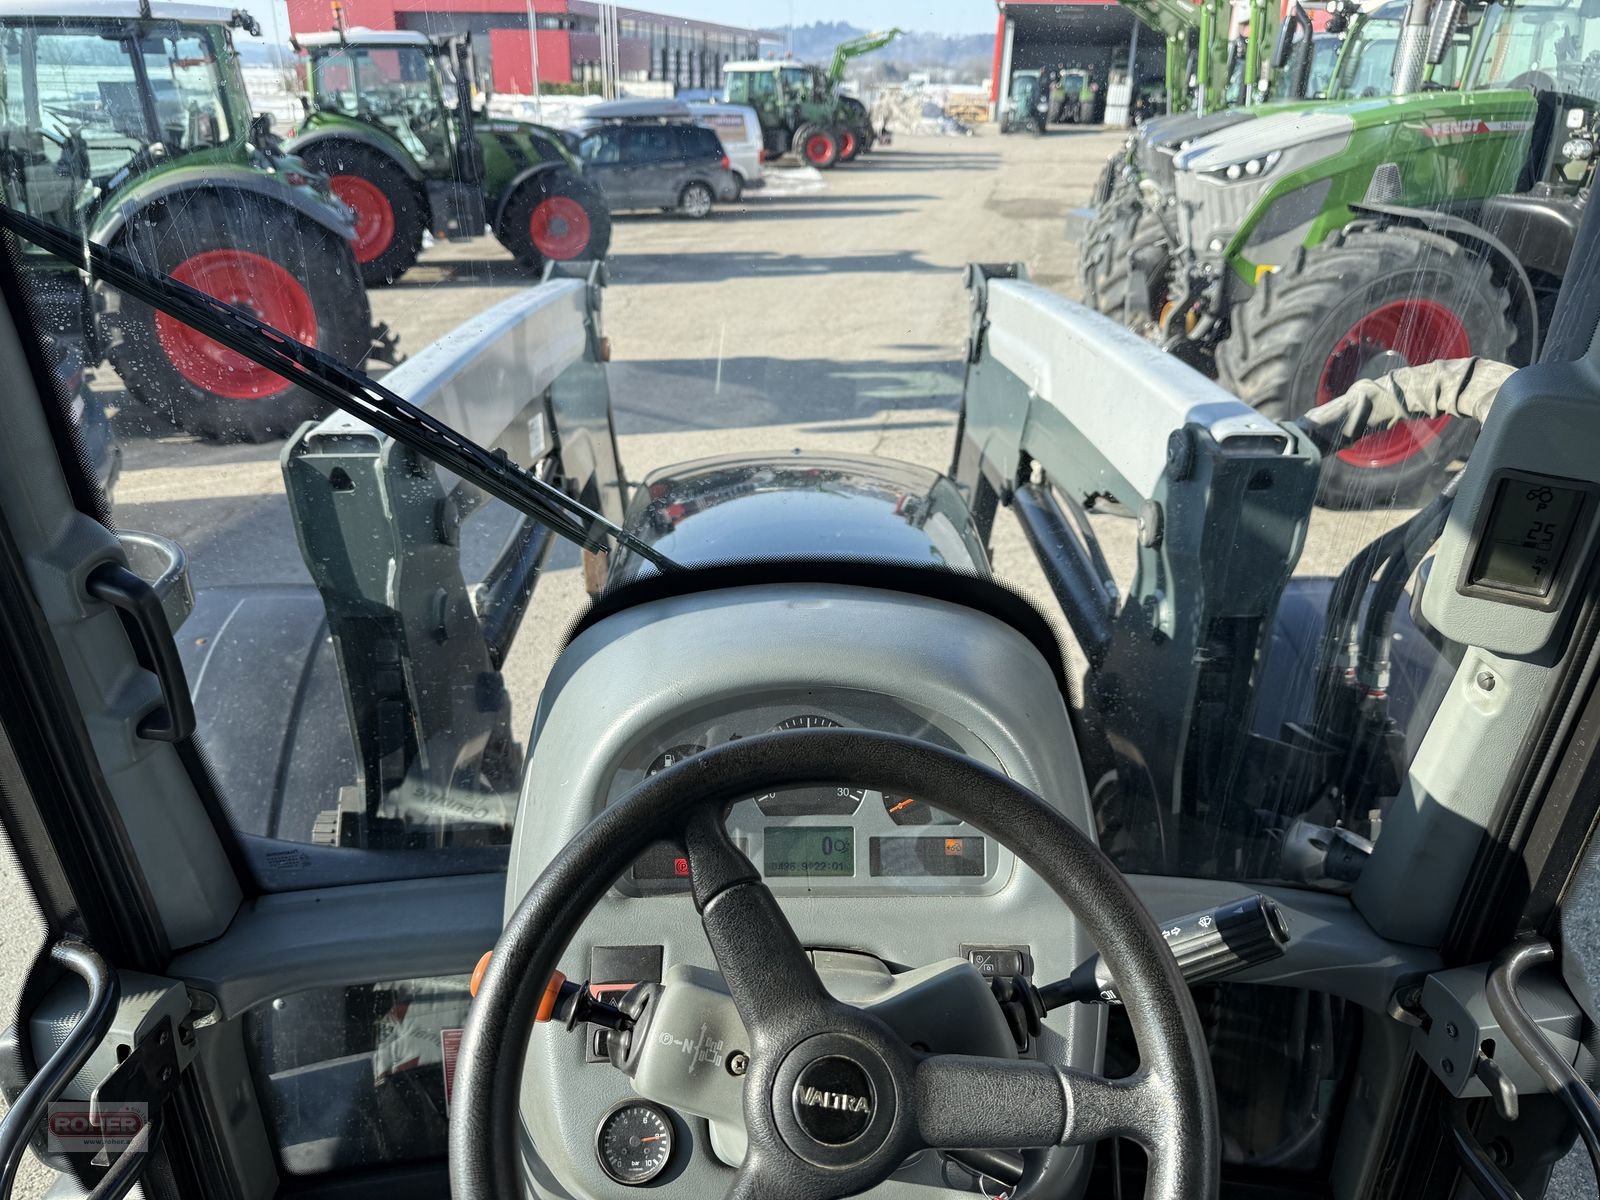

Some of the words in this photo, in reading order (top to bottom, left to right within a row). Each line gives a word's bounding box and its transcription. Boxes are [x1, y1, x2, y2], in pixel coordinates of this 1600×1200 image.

[1430, 119, 1483, 136] FENDT
[837, 787, 850, 797] 30
[682, 1038, 694, 1054] N
[799, 1085, 871, 1113] VALTRA
